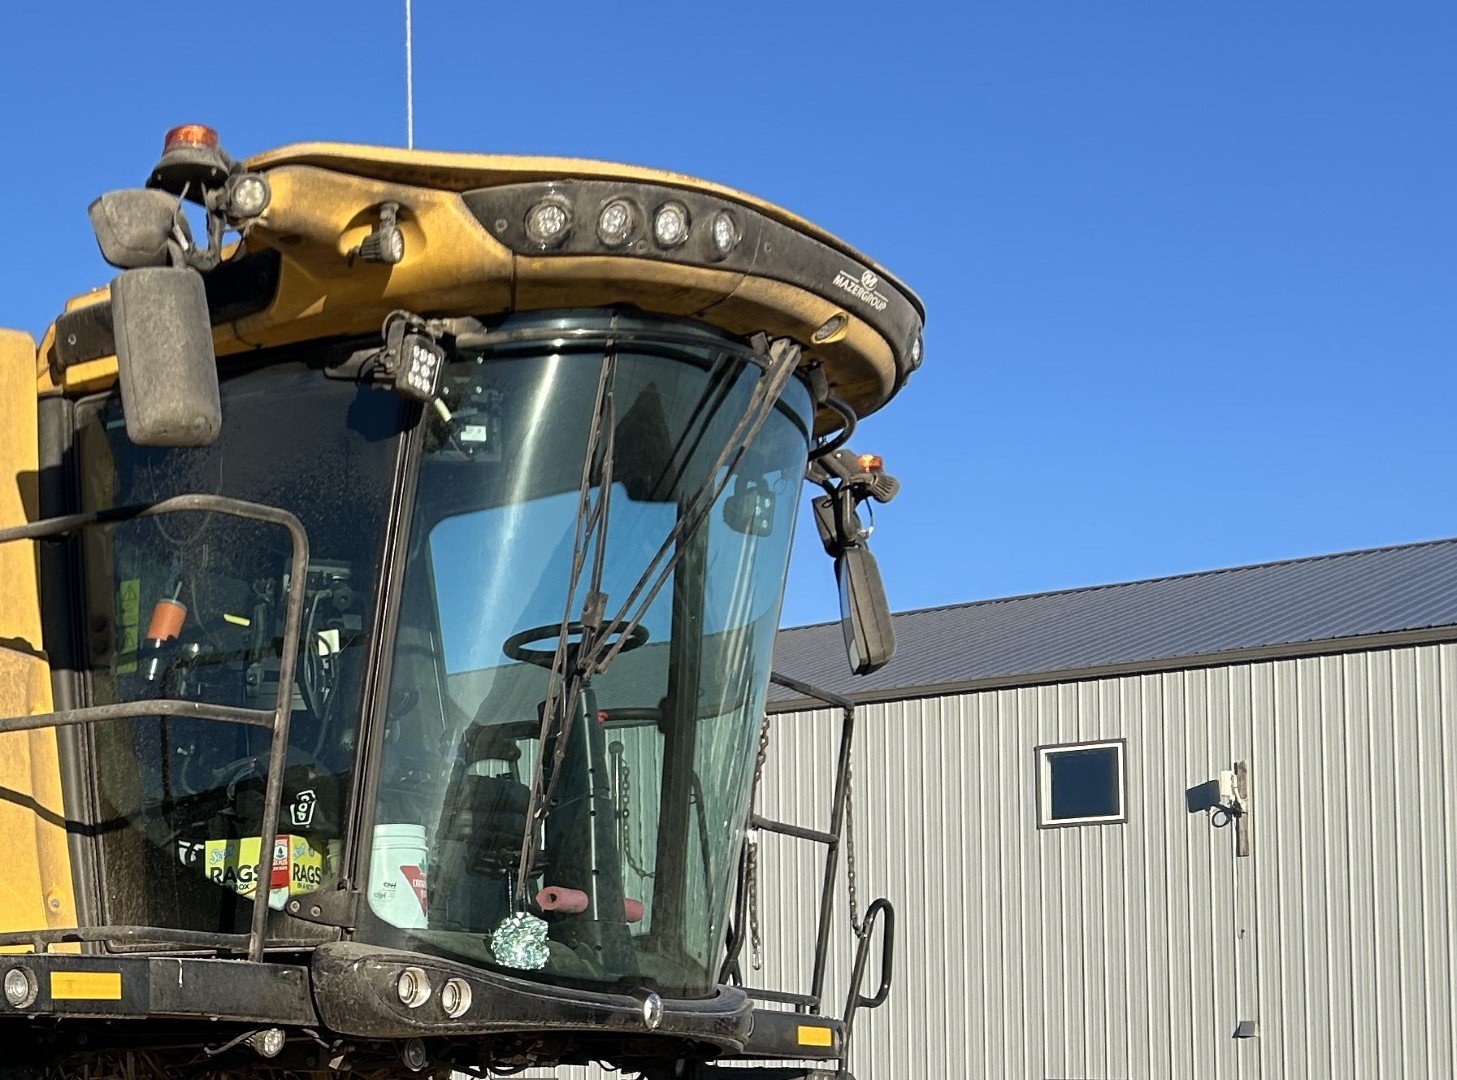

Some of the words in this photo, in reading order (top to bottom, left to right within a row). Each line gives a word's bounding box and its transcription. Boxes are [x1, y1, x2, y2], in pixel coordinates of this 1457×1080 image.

[833, 274, 887, 312] MAZERGROUP
[210, 865, 259, 884] RAGS
[293, 863, 322, 885] RAGS
